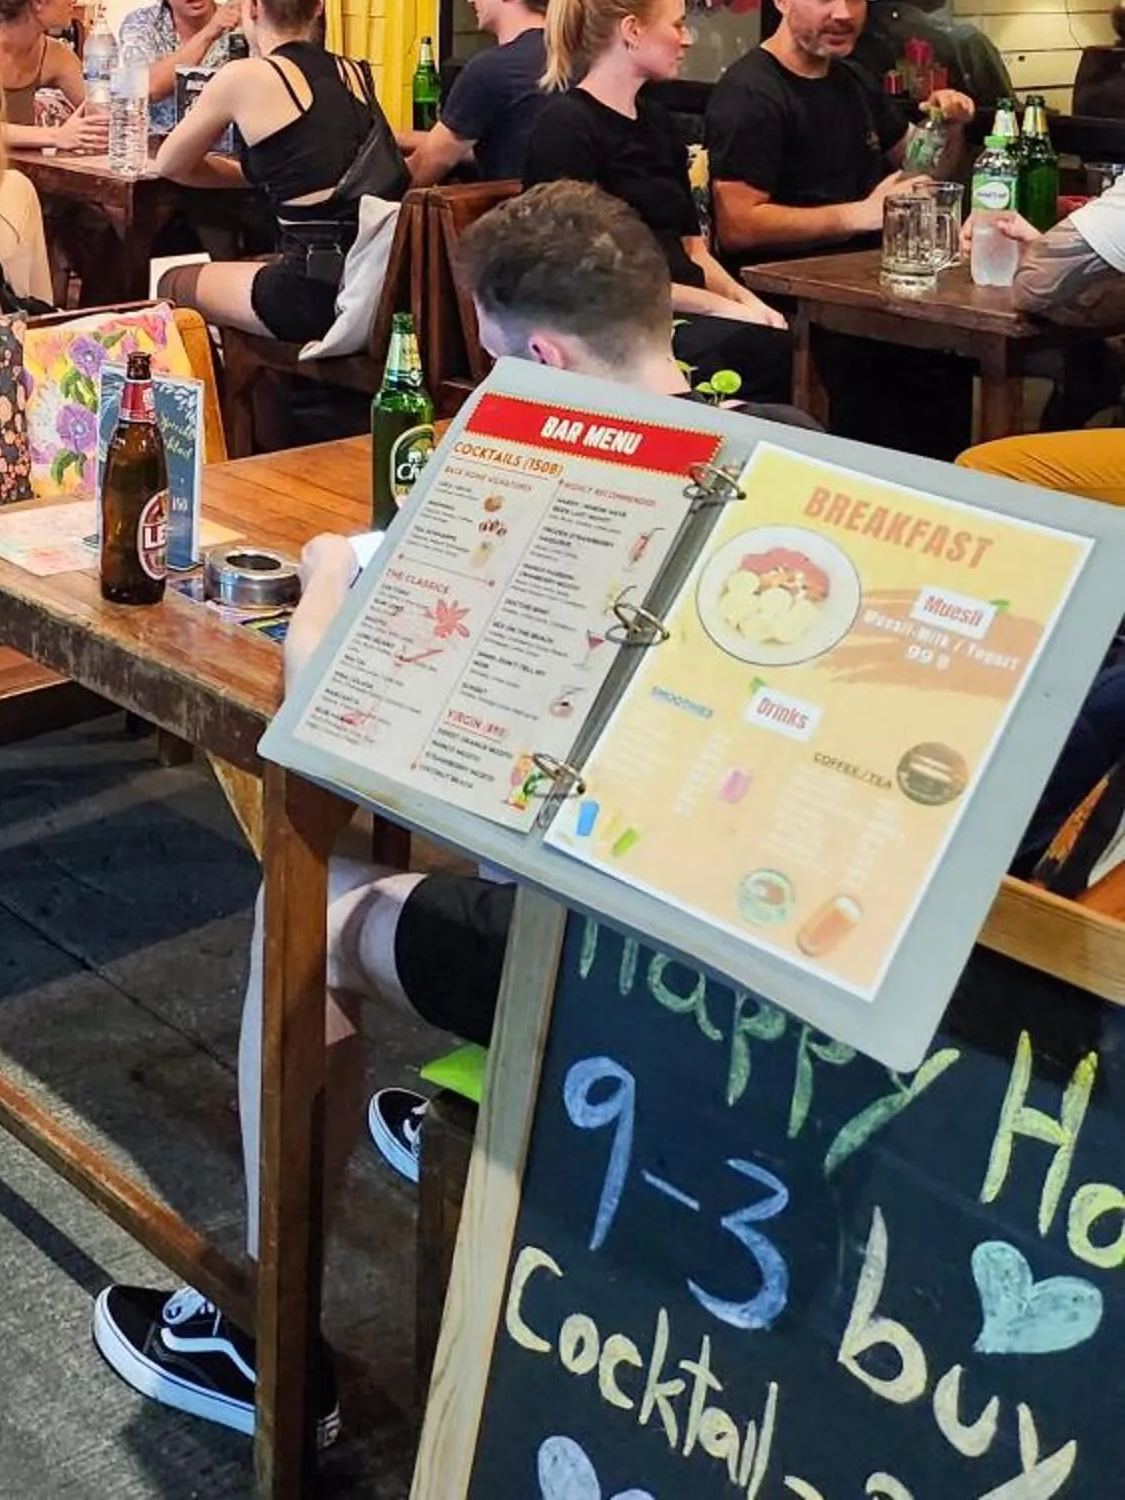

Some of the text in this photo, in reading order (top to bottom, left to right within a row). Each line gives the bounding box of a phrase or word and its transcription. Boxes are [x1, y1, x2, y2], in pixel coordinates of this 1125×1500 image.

[540, 416, 643, 455] BAR MENU
[454, 442, 523, 467] COCKTAILS
[804, 486, 994, 569] BREAKFAST
[923, 595, 985, 627] Muesli
[905, 645, 934, 665] 99
[756, 696, 810, 730] Drinks
[563, 1056, 789, 1331] 9-3
[838, 1205, 1078, 1500] buy
